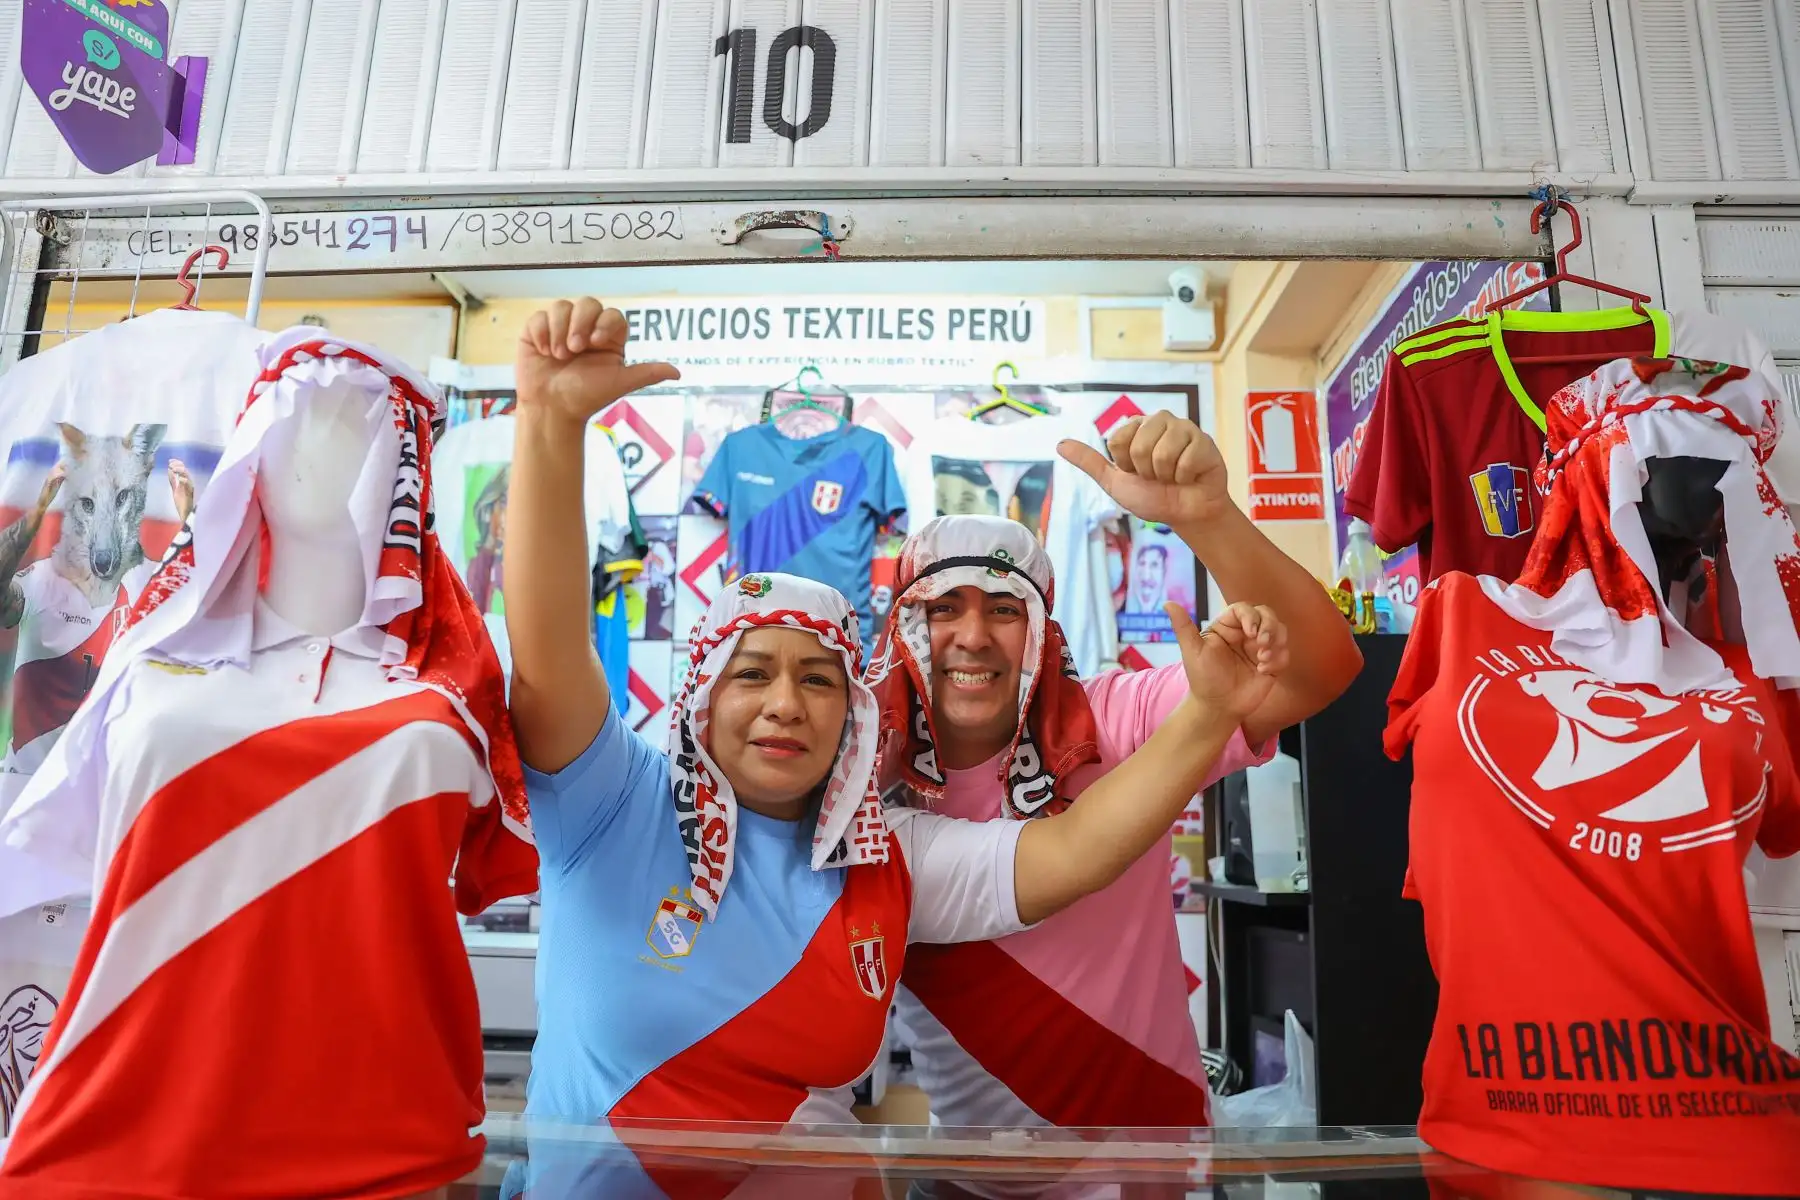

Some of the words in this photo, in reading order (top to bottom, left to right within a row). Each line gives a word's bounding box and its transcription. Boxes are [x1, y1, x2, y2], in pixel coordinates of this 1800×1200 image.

[89, 6, 125, 33] AQUÍ
[127, 27, 154, 50] CON
[49, 60, 137, 119] yape
[714, 25, 837, 143] 10
[127, 228, 193, 257] CEL:
[625, 306, 771, 342] ERVICIOS
[783, 306, 935, 342] TEXTILES
[948, 300, 1031, 343] PERÚ
[1250, 492, 1322, 507] XTINTOR
[1487, 487, 1524, 514] FVF
[1474, 648, 1521, 677] LA
[1568, 821, 1643, 862] 2008
[45, 914, 56, 924] S
[663, 920, 682, 945] SC
[858, 958, 881, 976] FPF
[1456, 1022, 1505, 1081] LA
[1486, 1089, 1540, 1114] BARRA
[1543, 1091, 1615, 1118] OFICIAL
[1617, 1093, 1643, 1119] DE
[1649, 1092, 1673, 1119] LA
